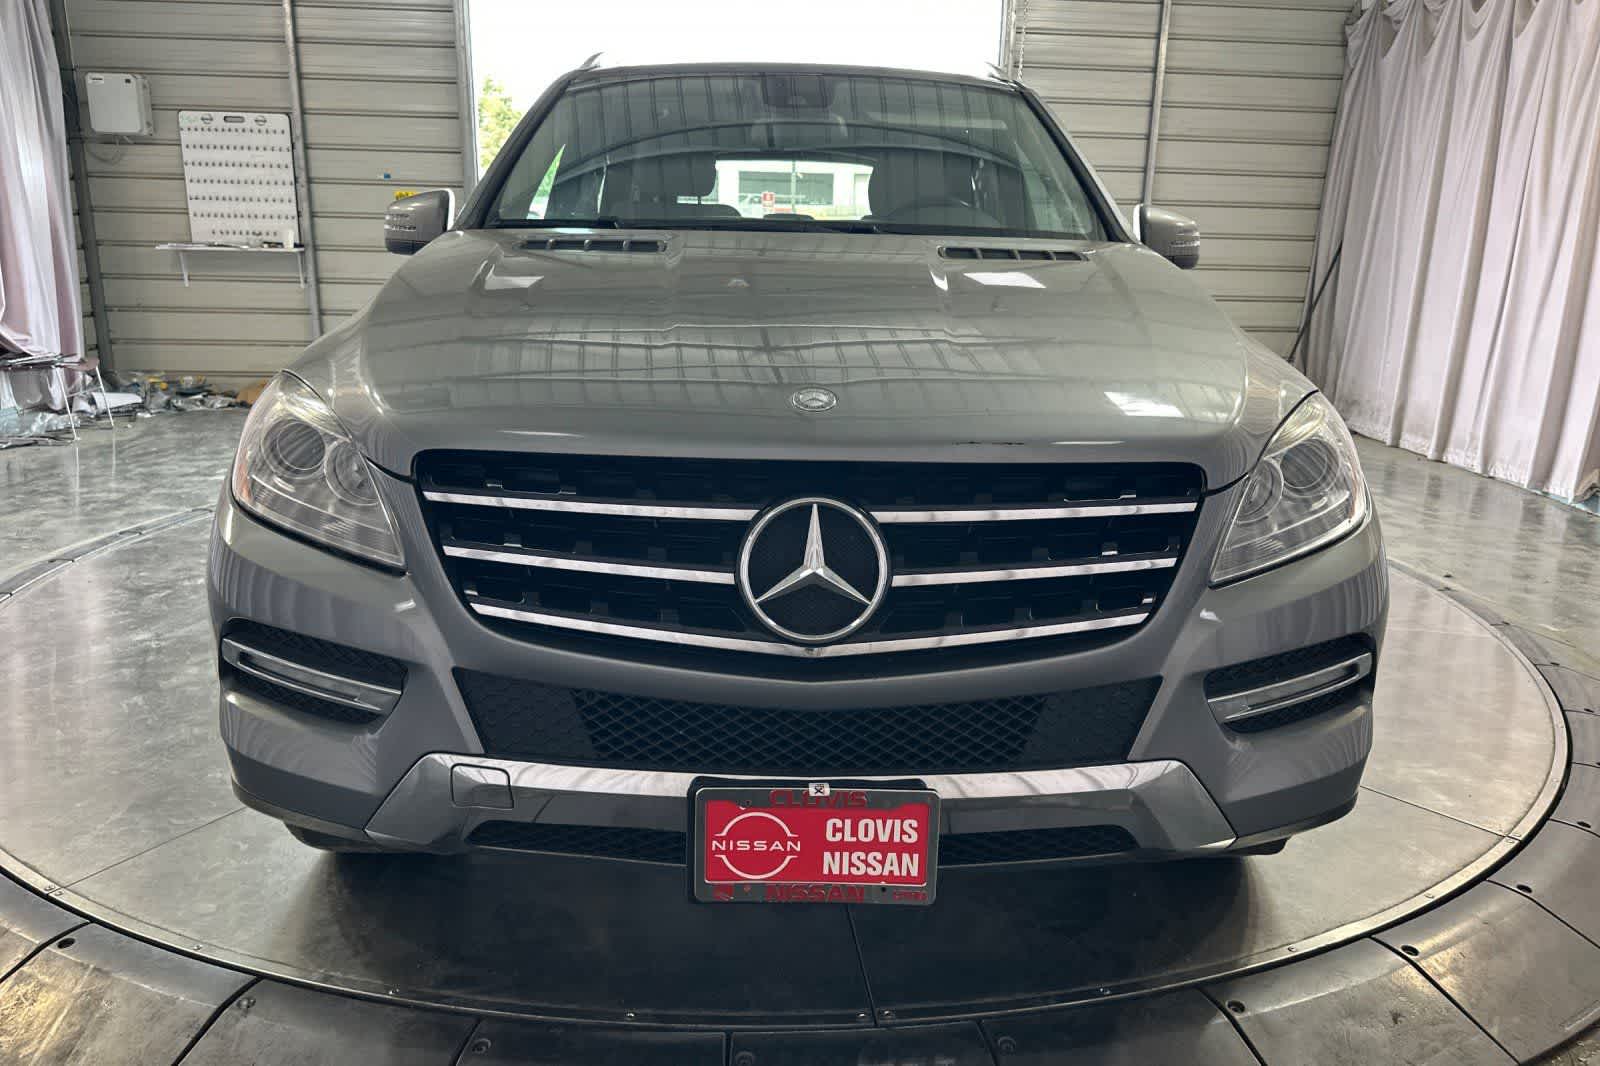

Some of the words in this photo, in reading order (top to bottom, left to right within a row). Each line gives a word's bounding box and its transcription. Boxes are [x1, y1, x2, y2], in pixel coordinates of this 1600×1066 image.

[825, 818, 919, 843] CLOVIS
[711, 840, 801, 852] NISSAN
[822, 851, 920, 877] NISSAN
[766, 885, 865, 902] NISSAN
